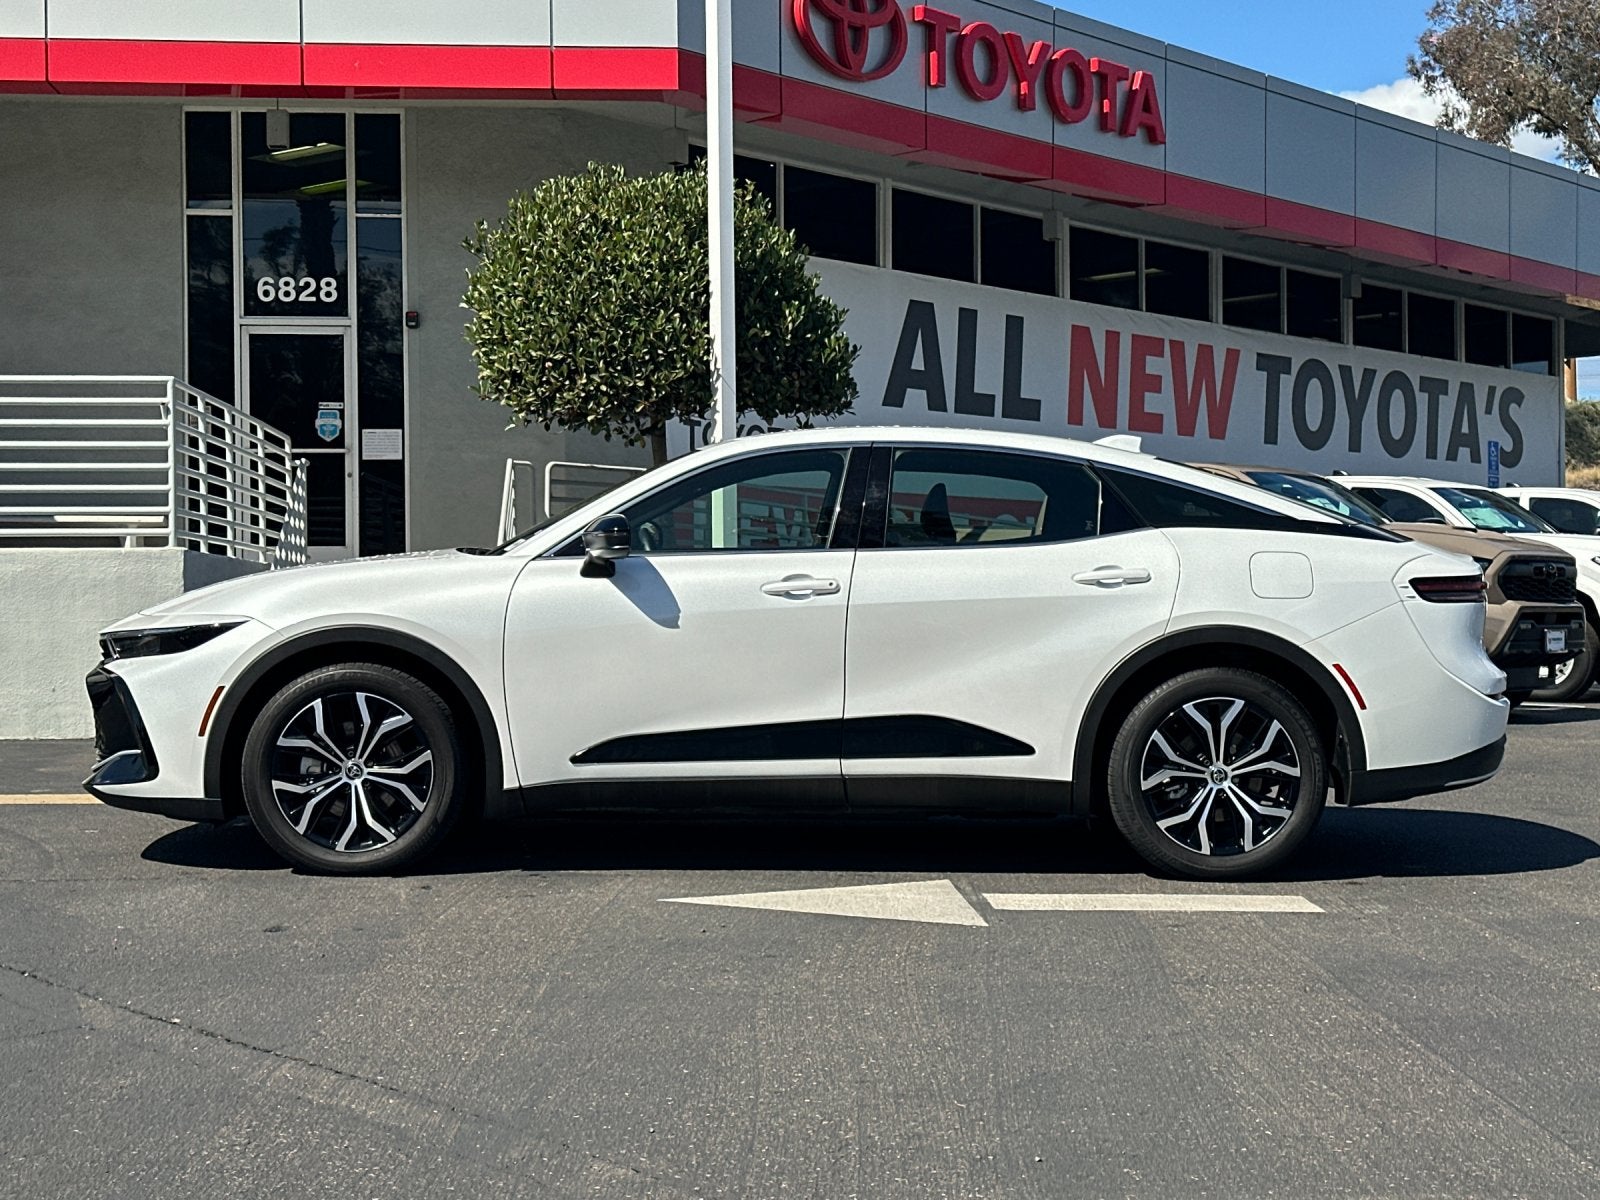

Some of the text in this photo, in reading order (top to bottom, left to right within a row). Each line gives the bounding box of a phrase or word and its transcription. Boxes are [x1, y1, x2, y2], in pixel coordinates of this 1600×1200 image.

[913, 5, 1166, 144] TOYOTA
[257, 277, 338, 302] 6828
[882, 299, 1525, 469] ALL NEW TOYOTA'S
